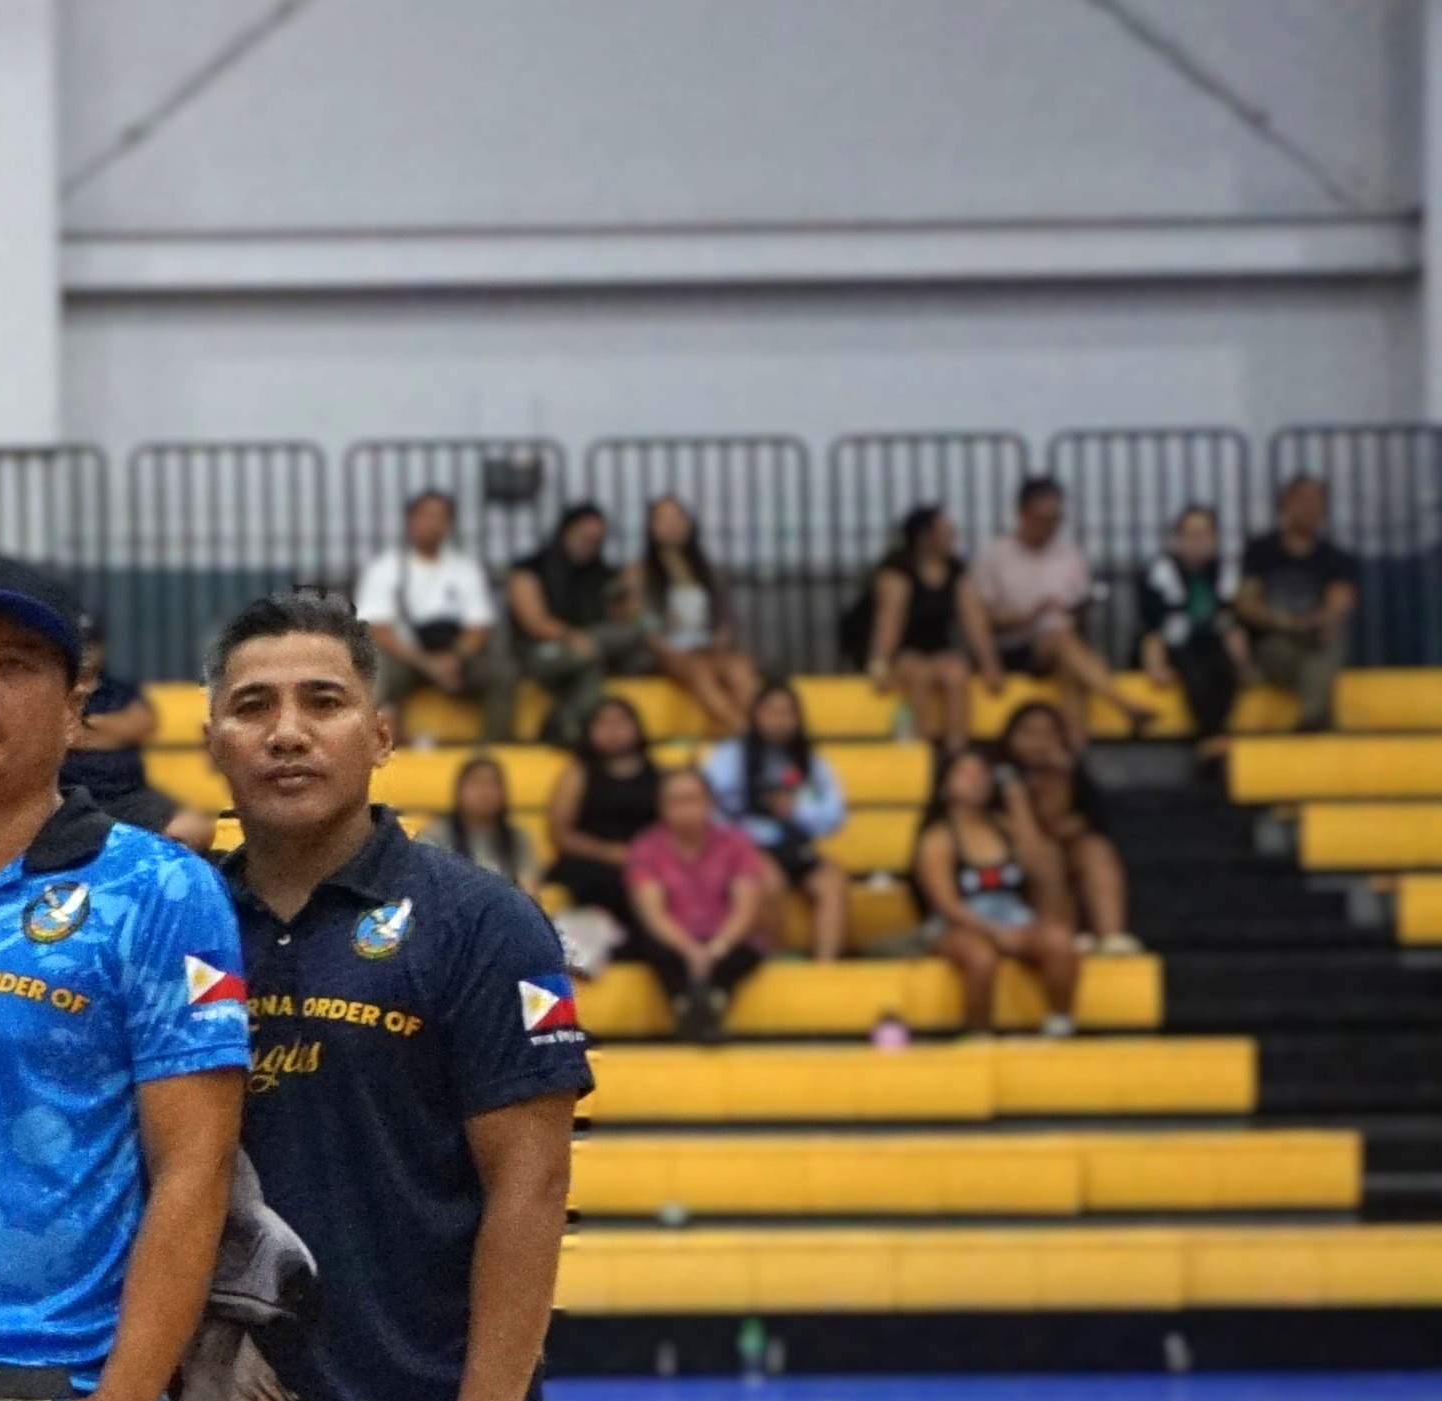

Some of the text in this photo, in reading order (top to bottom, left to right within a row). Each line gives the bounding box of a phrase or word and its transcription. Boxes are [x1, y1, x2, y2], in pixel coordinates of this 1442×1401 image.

[50, 988, 90, 1013] OF
[302, 997, 381, 1027] ORDER
[384, 1010, 424, 1036] OF
